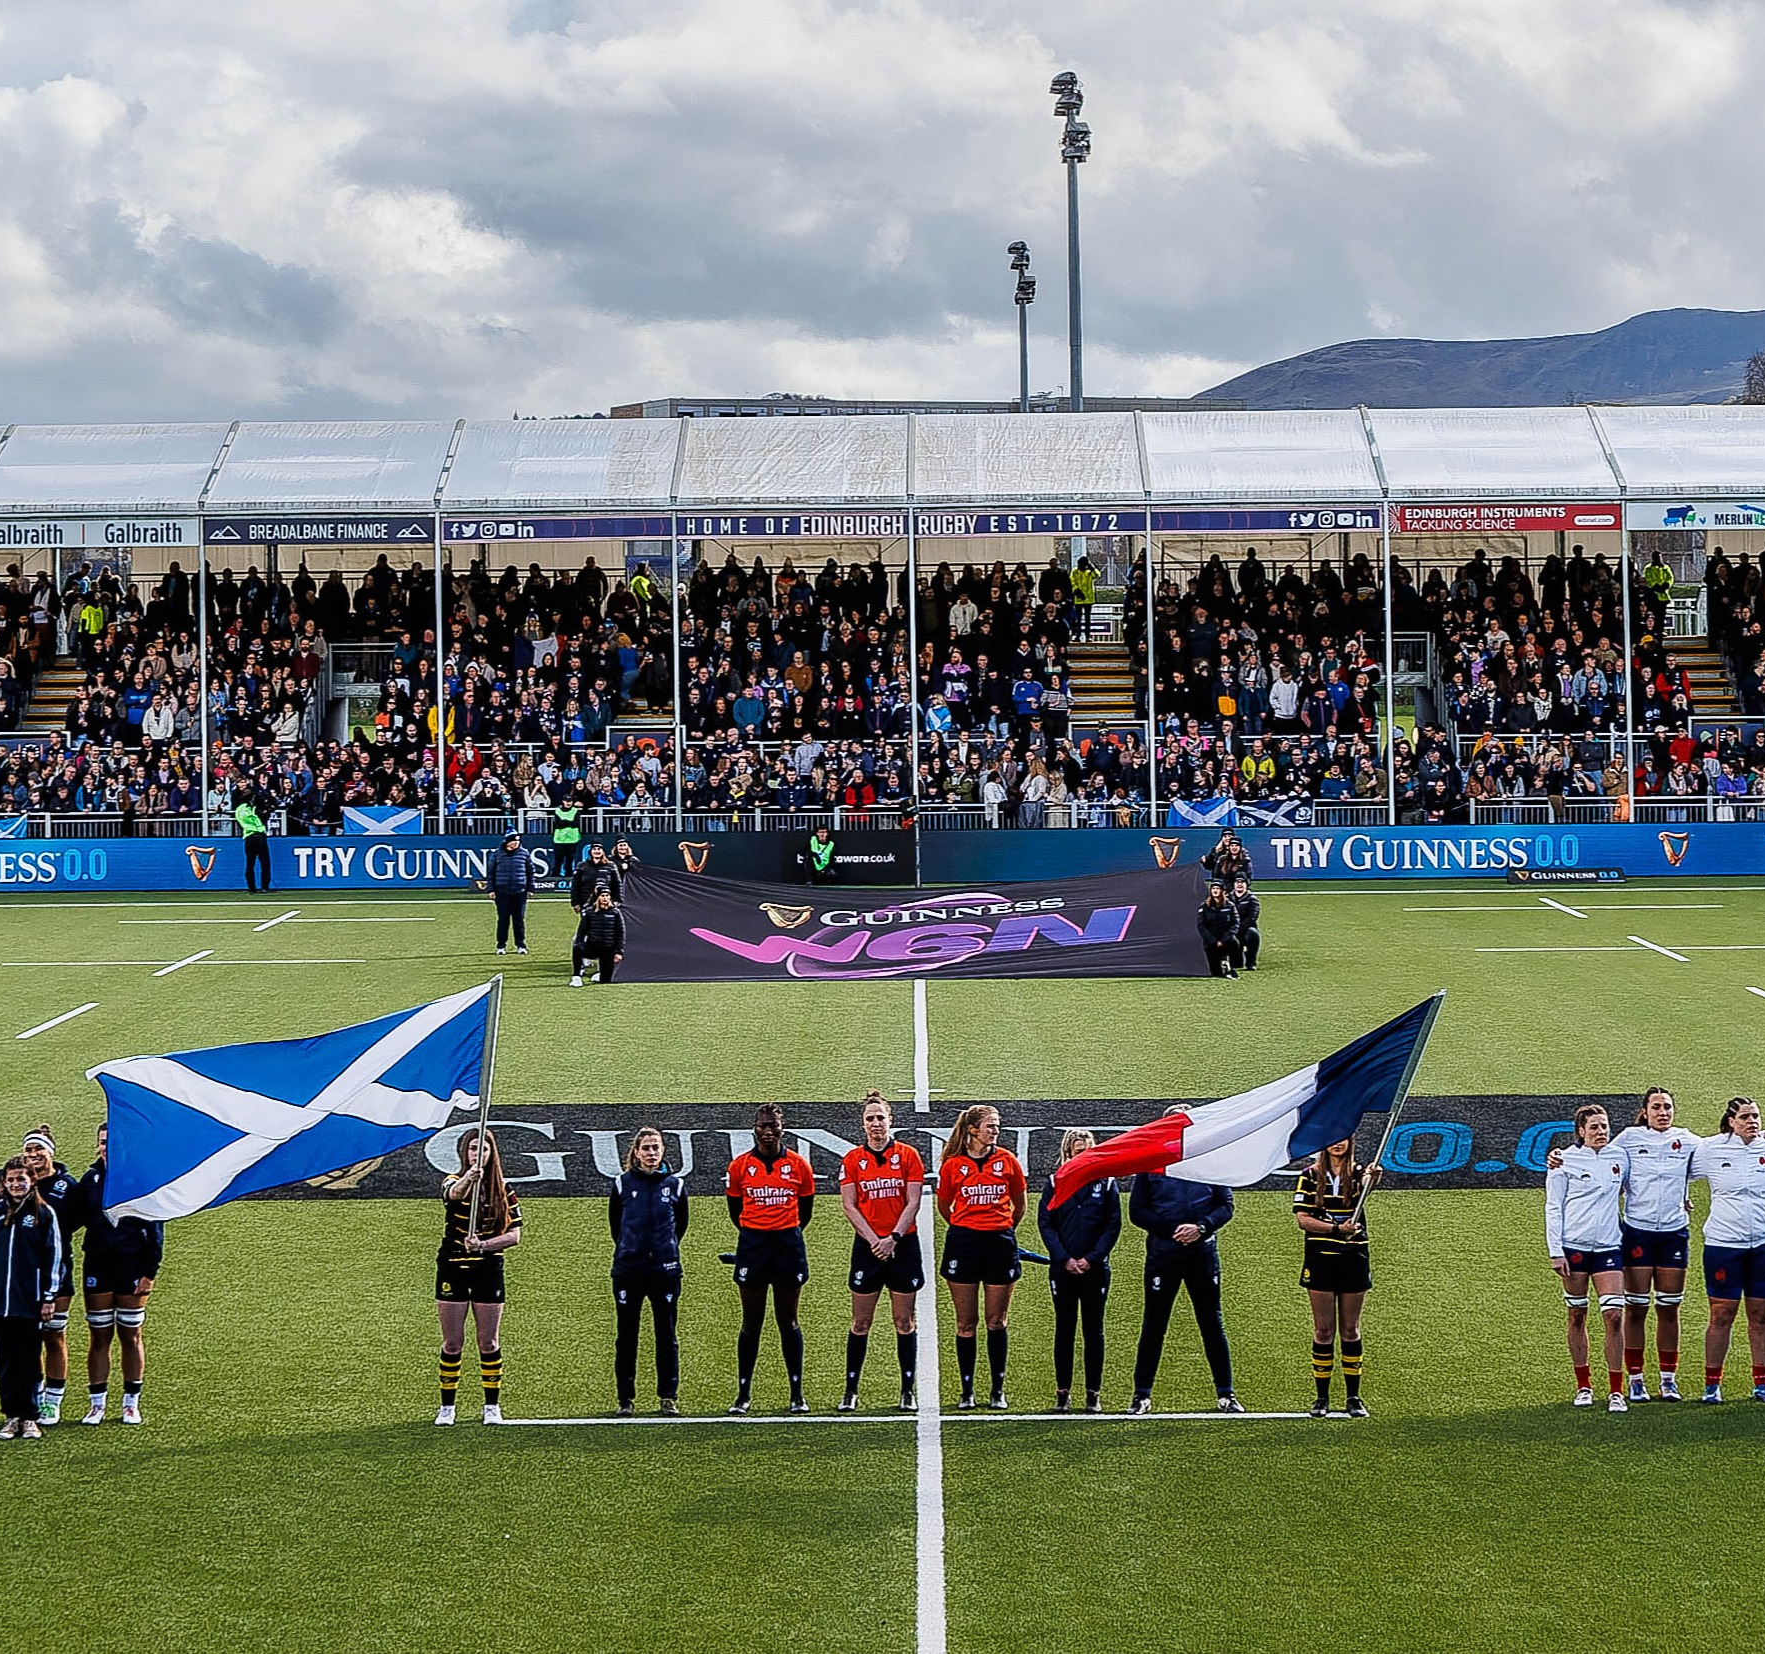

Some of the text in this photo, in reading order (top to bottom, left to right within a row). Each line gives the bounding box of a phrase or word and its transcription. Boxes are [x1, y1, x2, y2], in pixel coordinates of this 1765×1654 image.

[1404, 506, 1566, 519] EDINBURGH INSTRUMENTS
[104, 522, 183, 543] Galbraith
[248, 522, 389, 540] BREADALBANE FINANCE
[686, 517, 748, 535] HOME
[765, 517, 791, 534] OF
[799, 516, 905, 535] EDINBURGH
[917, 514, 978, 535] RUGBY
[1404, 518, 1516, 530] TACKLING SCIENCE
[796, 852, 897, 865] baware.co.uk
[1270, 833, 1580, 871] TRY GUINNESS 0.0
[62, 847, 108, 882] 0.0
[293, 846, 356, 878] TRY
[364, 843, 550, 881] GUINNS
[1598, 870, 1619, 879] 0.0
[819, 897, 1066, 928] GUINNESS
[860, 1177, 905, 1192] Emirates
[960, 1183, 1007, 1198] Emirates
